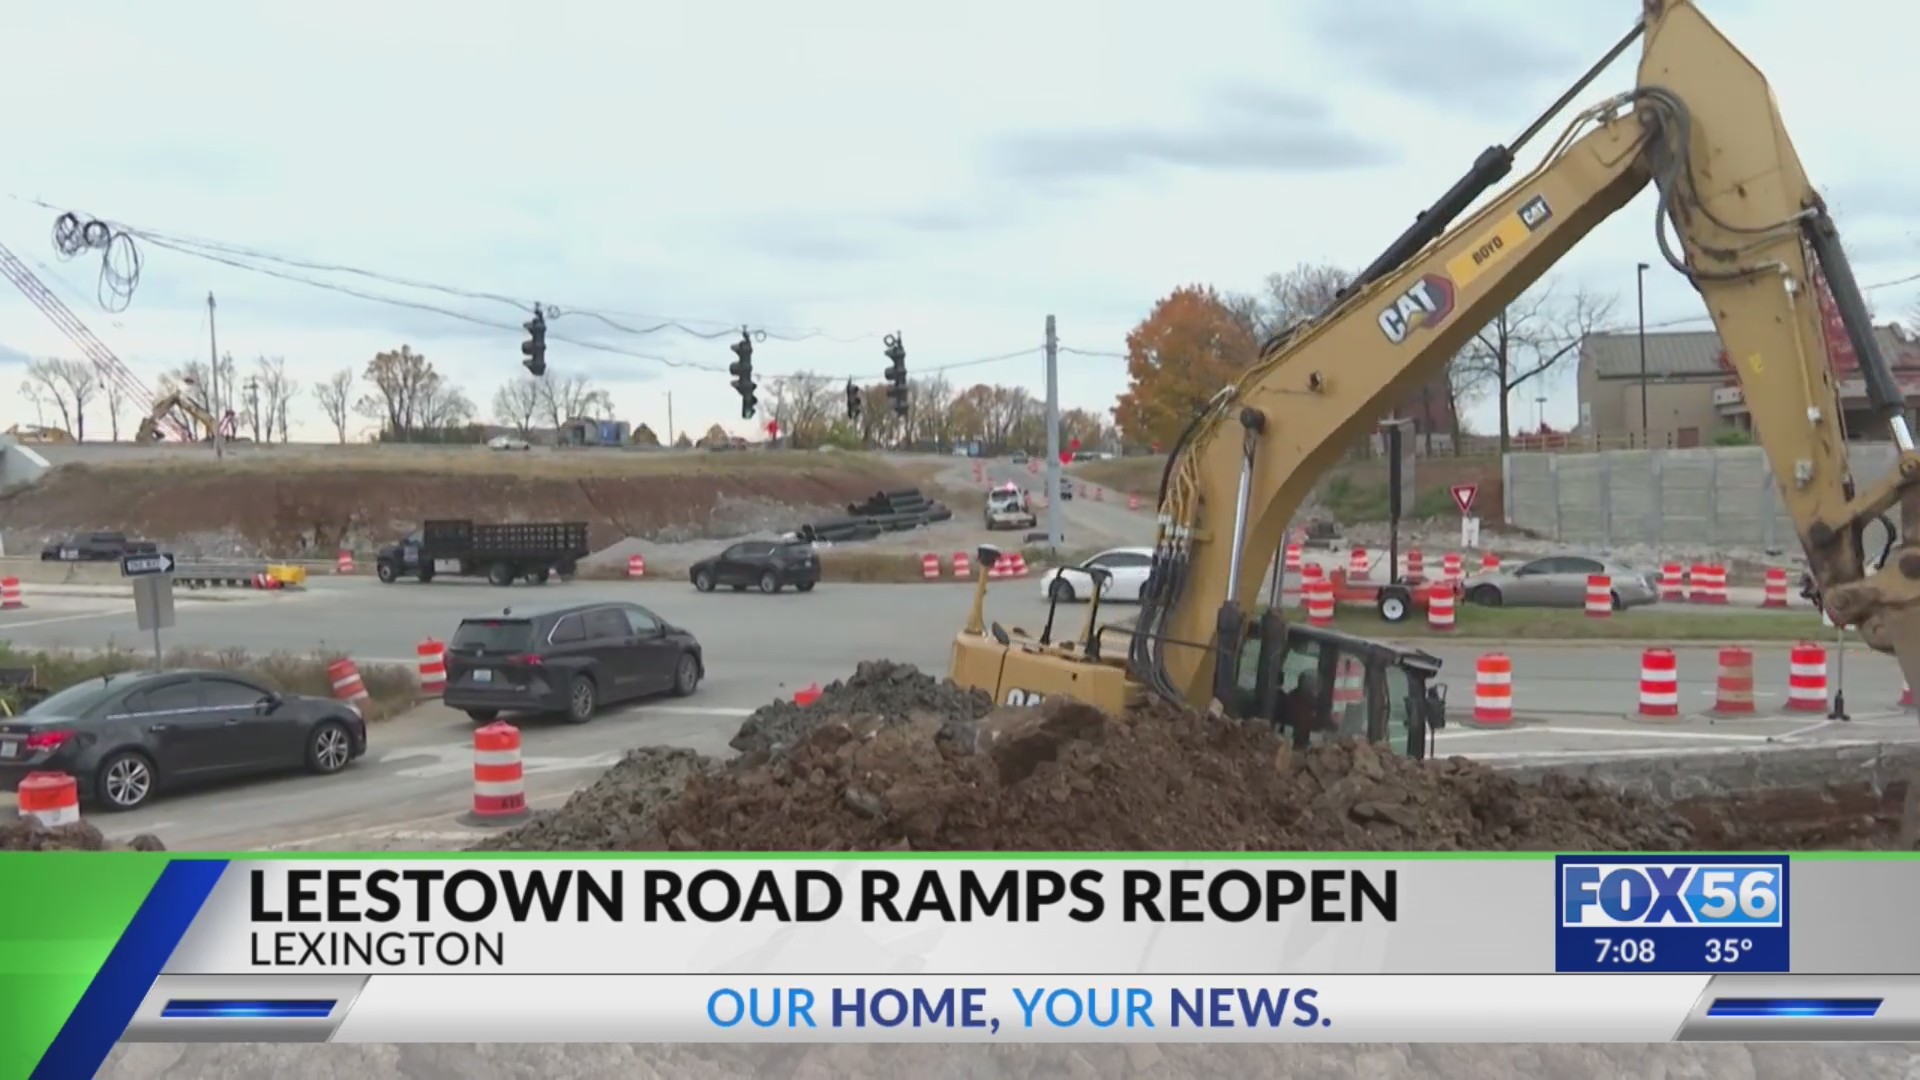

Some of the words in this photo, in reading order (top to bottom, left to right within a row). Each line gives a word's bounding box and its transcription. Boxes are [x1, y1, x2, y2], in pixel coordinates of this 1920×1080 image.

[1521, 200, 1546, 226] CAT
[1472, 236, 1504, 265] BOYD
[1378, 279, 1437, 342] CAT
[1007, 687, 1047, 706] CA
